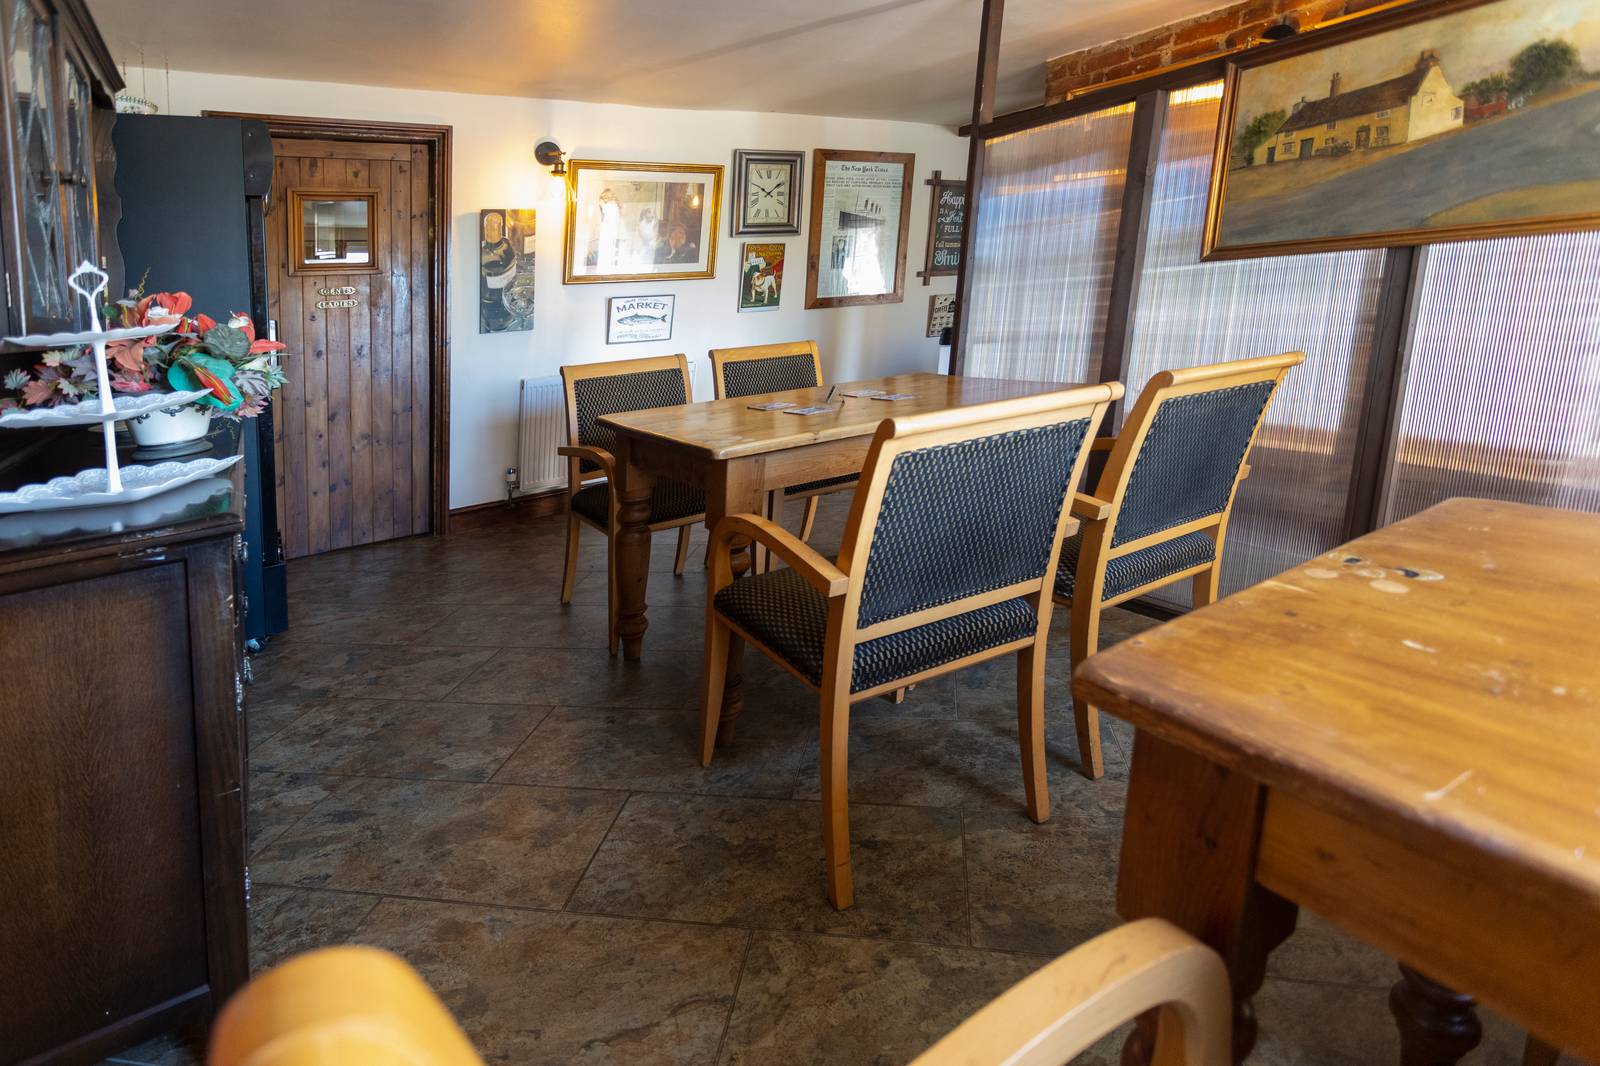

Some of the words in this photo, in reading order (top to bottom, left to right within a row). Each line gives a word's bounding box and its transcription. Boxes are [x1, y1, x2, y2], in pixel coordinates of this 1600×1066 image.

[841, 164, 850, 172] The
[862, 165, 874, 173] York
[940, 190, 966, 209] Happi
[944, 225, 960, 233] FULL
[616, 302, 668, 312] MARKET
